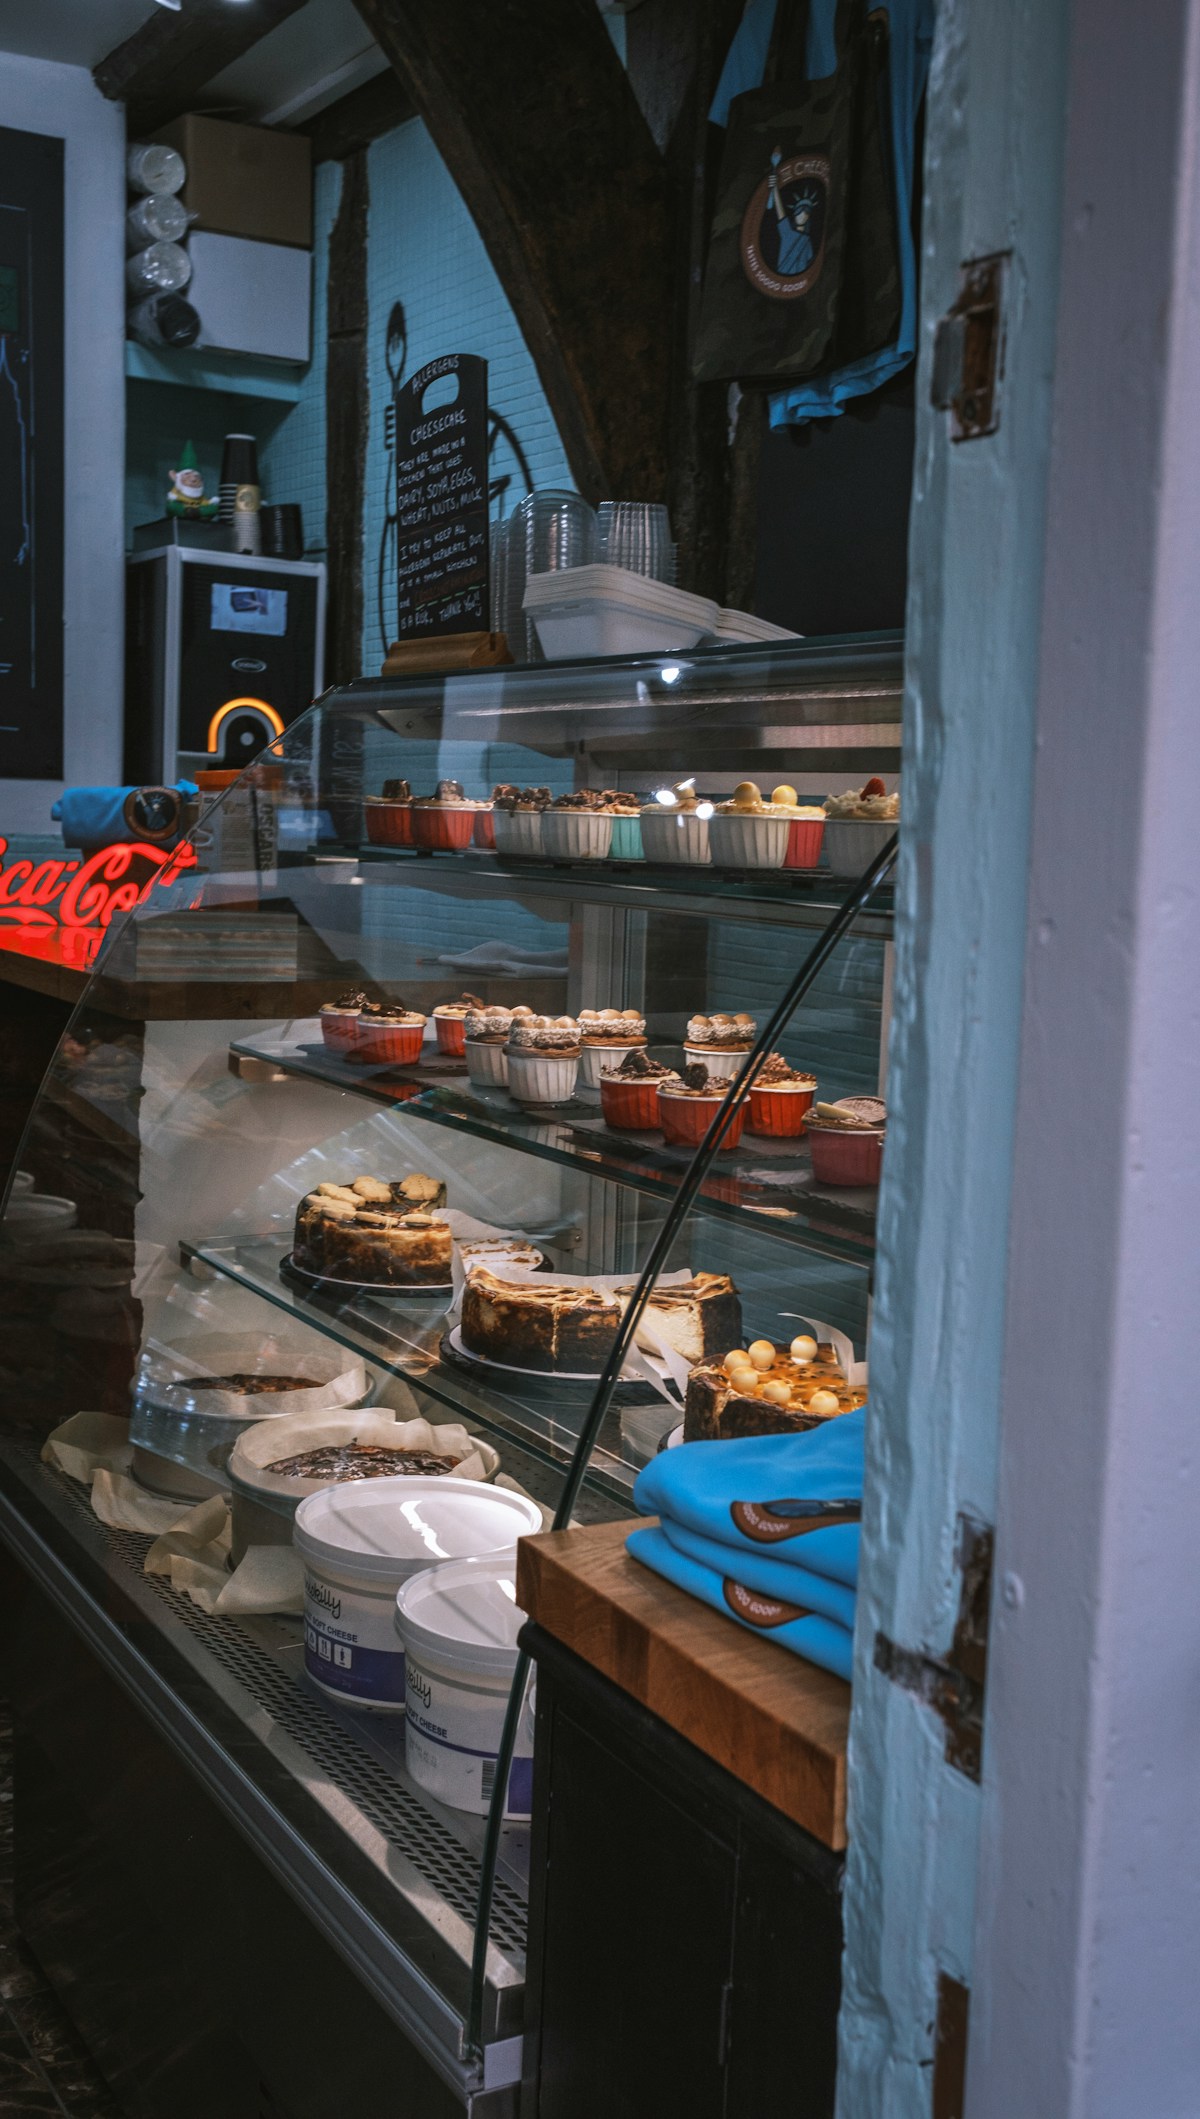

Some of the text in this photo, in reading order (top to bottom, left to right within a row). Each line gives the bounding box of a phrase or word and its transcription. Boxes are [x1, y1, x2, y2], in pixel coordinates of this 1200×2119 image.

[412, 355, 459, 395] ALLERGENS
[410, 409, 467, 446] CHEESECAKE
[427, 461, 444, 474] THAT
[460, 487, 483, 507] MILK
[327, 1625, 358, 1643] CHEESE
[419, 1717, 448, 1739] CHEESE
